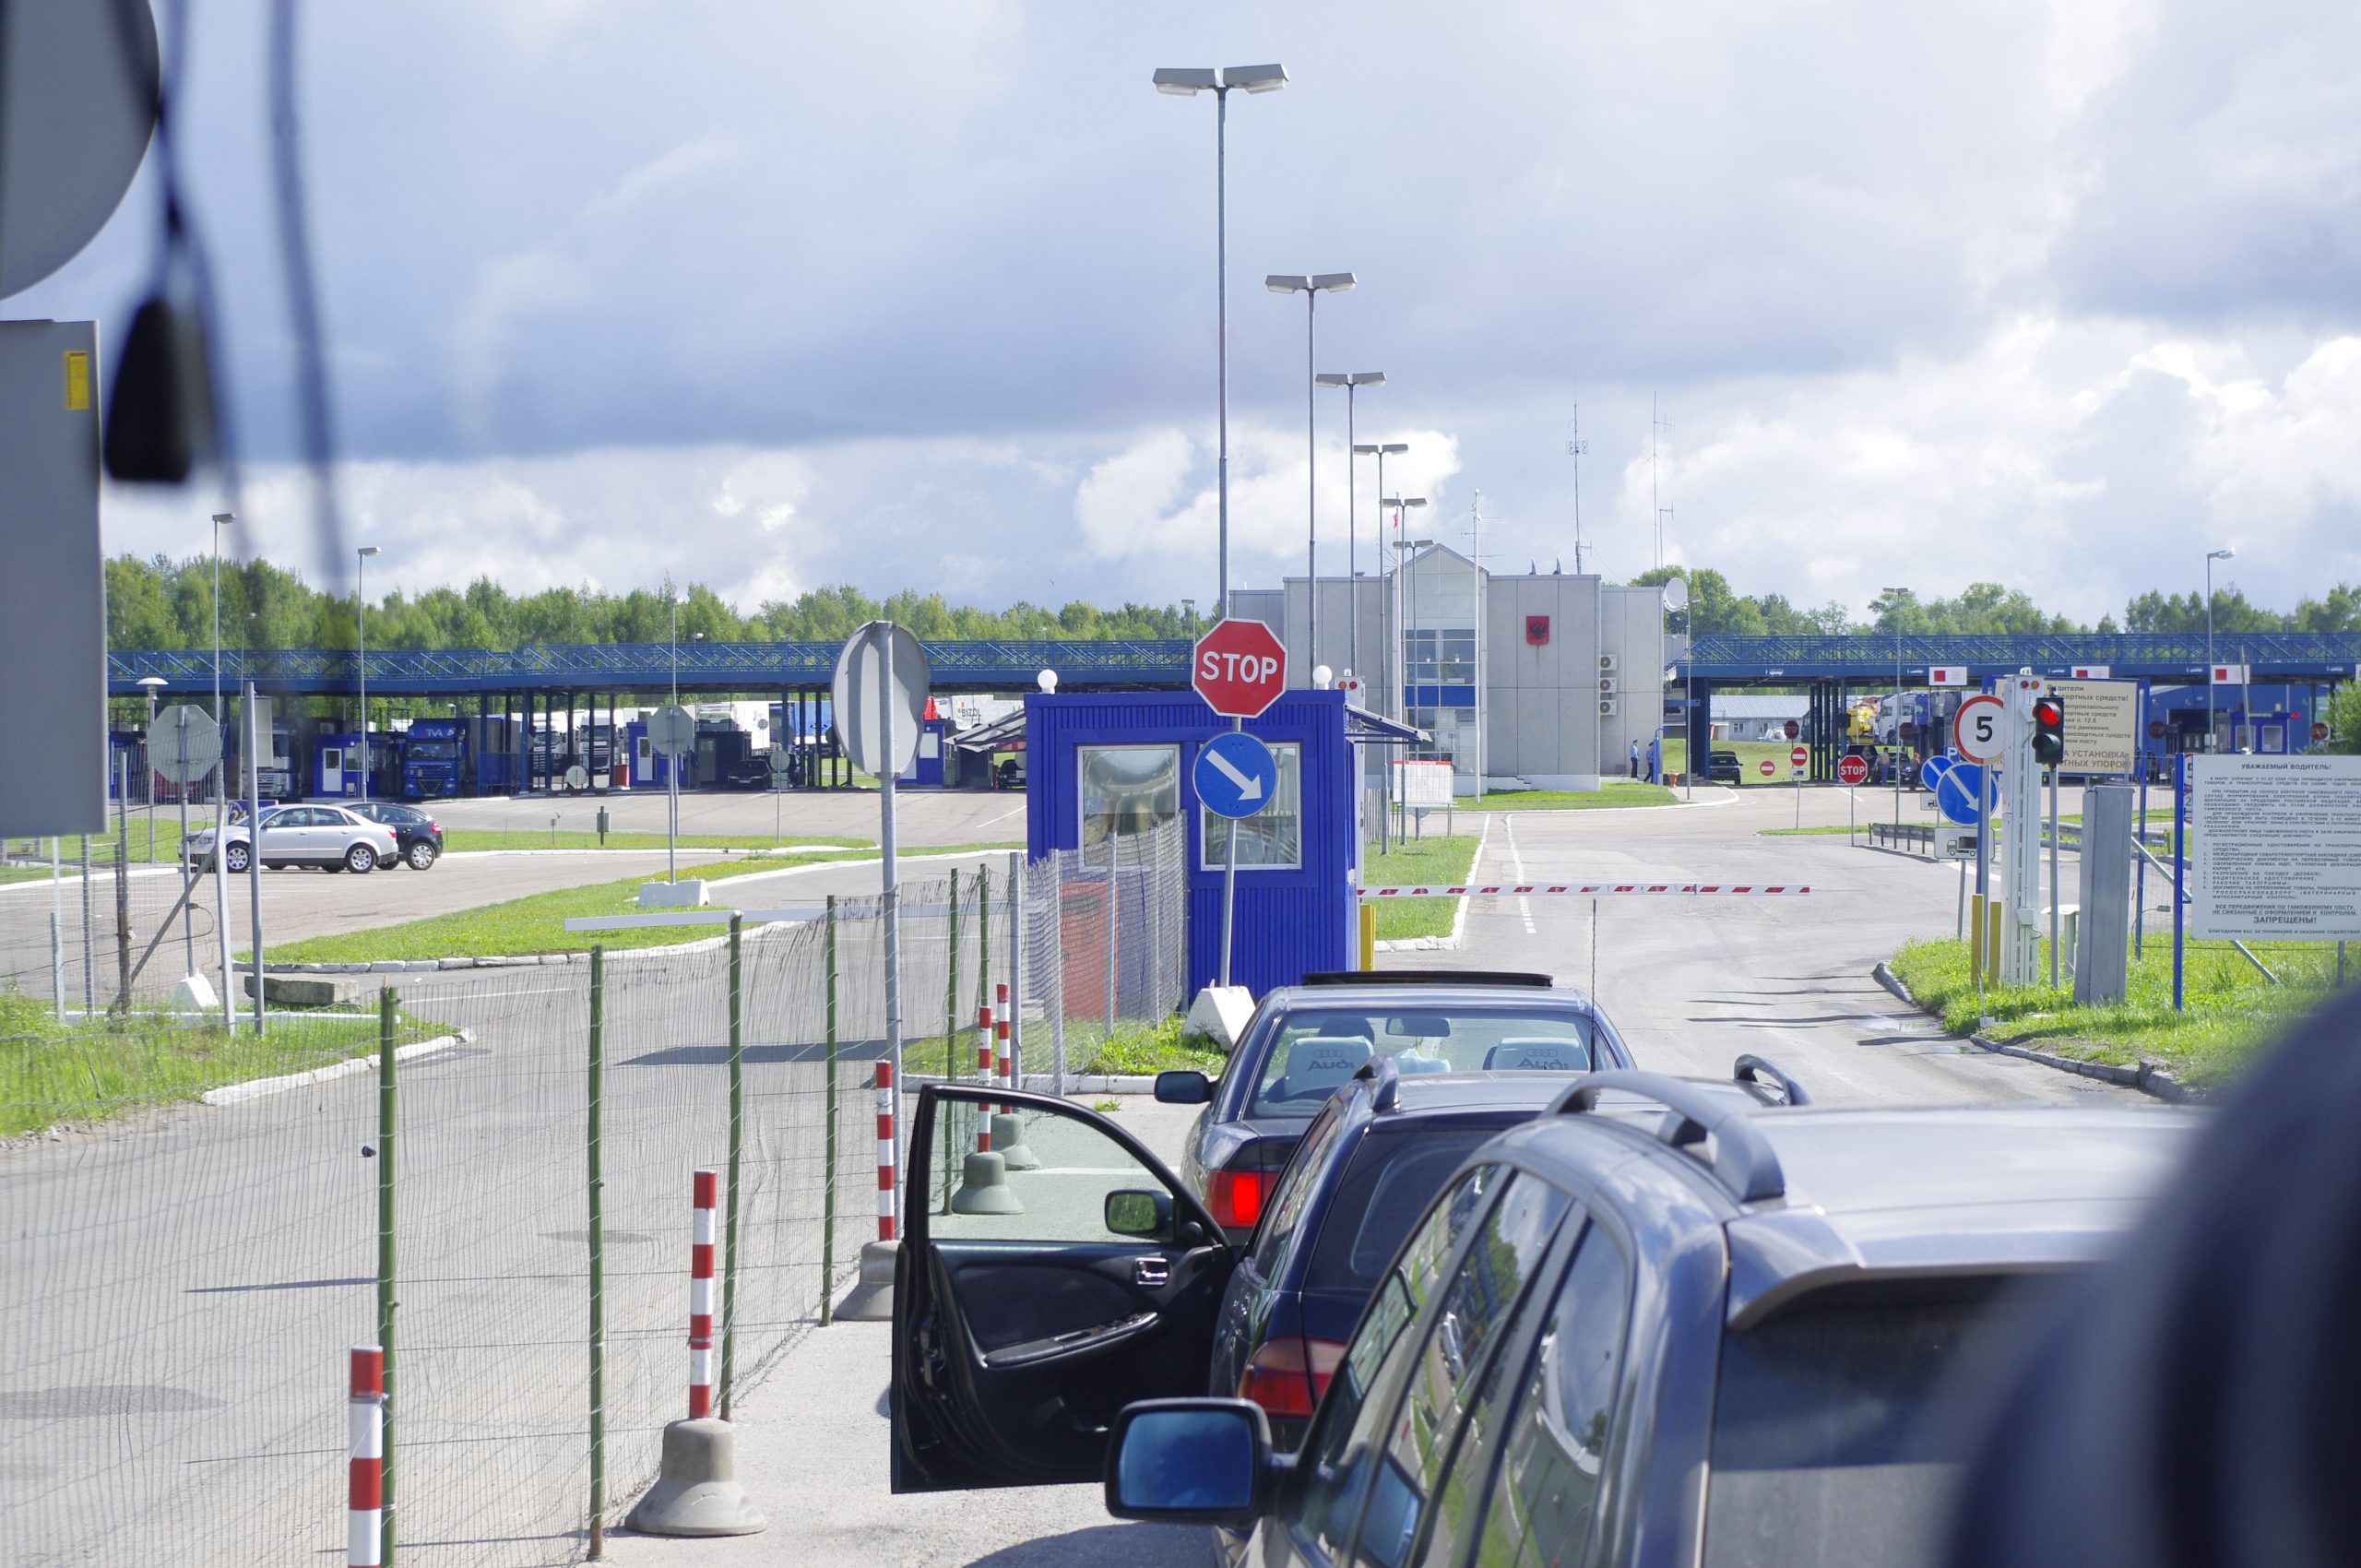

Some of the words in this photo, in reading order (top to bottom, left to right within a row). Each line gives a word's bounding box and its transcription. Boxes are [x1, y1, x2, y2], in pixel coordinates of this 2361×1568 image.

[1201, 651, 1277, 684] STOP
[1975, 716, 1992, 742] 5
[1948, 747, 1957, 760] P
[1839, 766, 1865, 776] STOP
[2254, 916, 2317, 924] ЗАПРЕЩЕНЫ!
